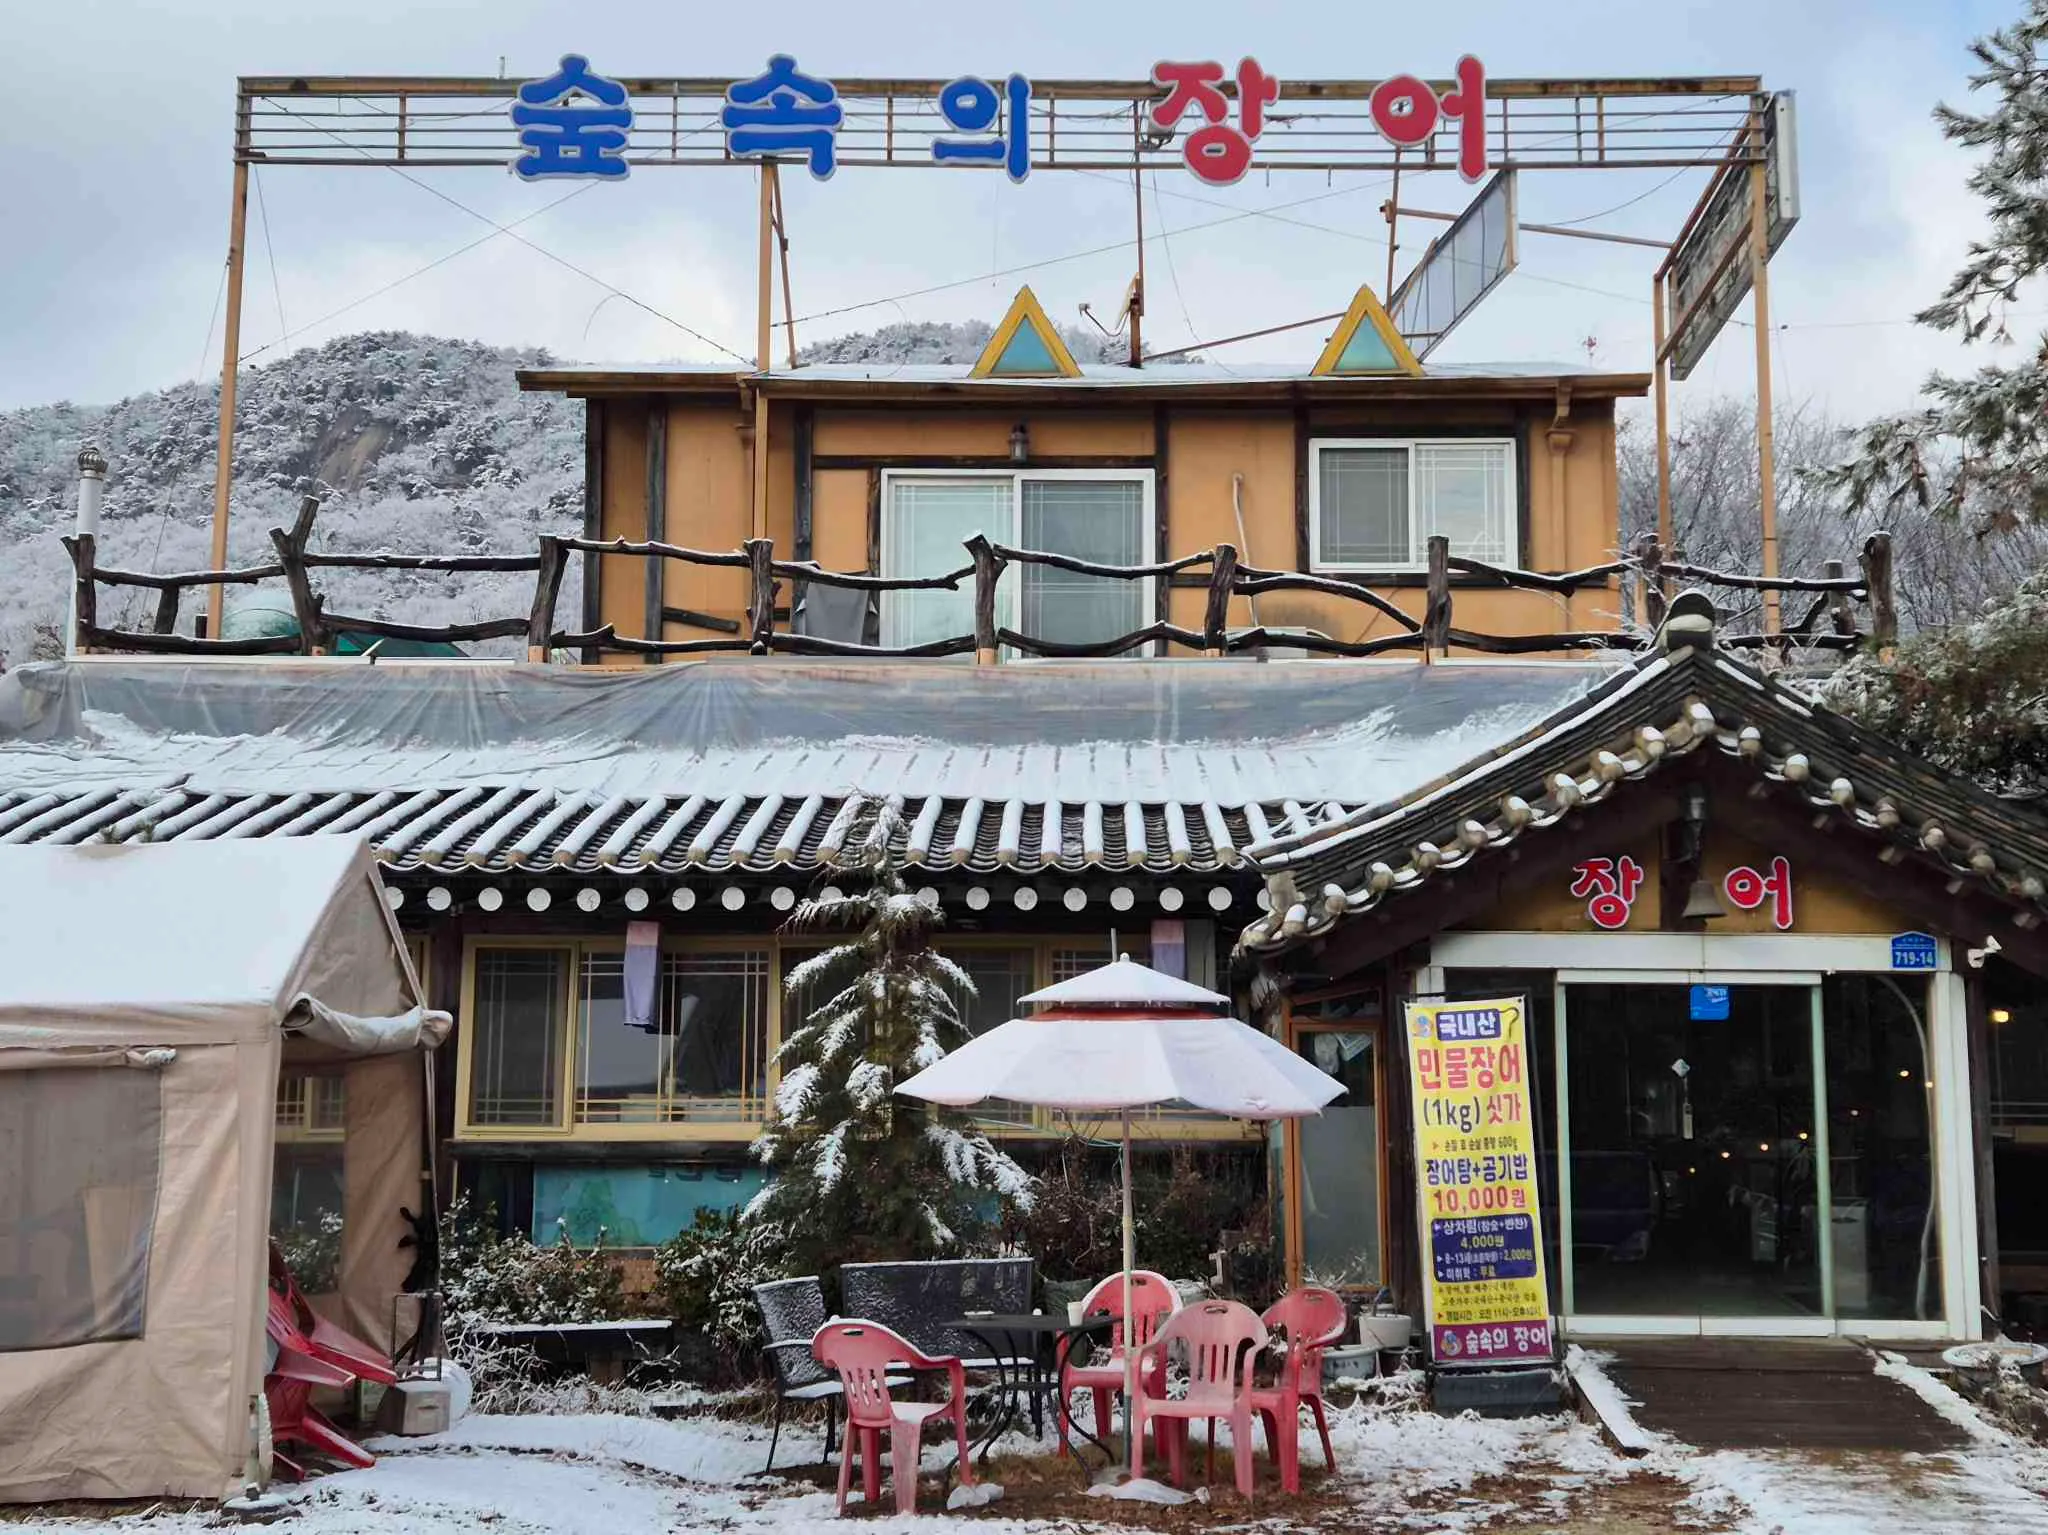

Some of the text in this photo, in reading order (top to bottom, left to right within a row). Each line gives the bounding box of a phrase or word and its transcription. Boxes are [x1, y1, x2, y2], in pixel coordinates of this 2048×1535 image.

[509, 54, 1488, 186] 숲속의 장어
[1570, 855, 1794, 930] 장어
[1894, 950, 1934, 966] 719-14
[1438, 1010, 1497, 1038] 국내산
[1416, 1042, 1521, 1090] 민물장어
[1423, 1092, 1521, 1134] (1kg) 싯가
[1426, 1152, 1529, 1186] 장어탕+공기밥
[1432, 1185, 1527, 1215] 10,000원
[1465, 1326, 1547, 1355] 숲속의 장어
